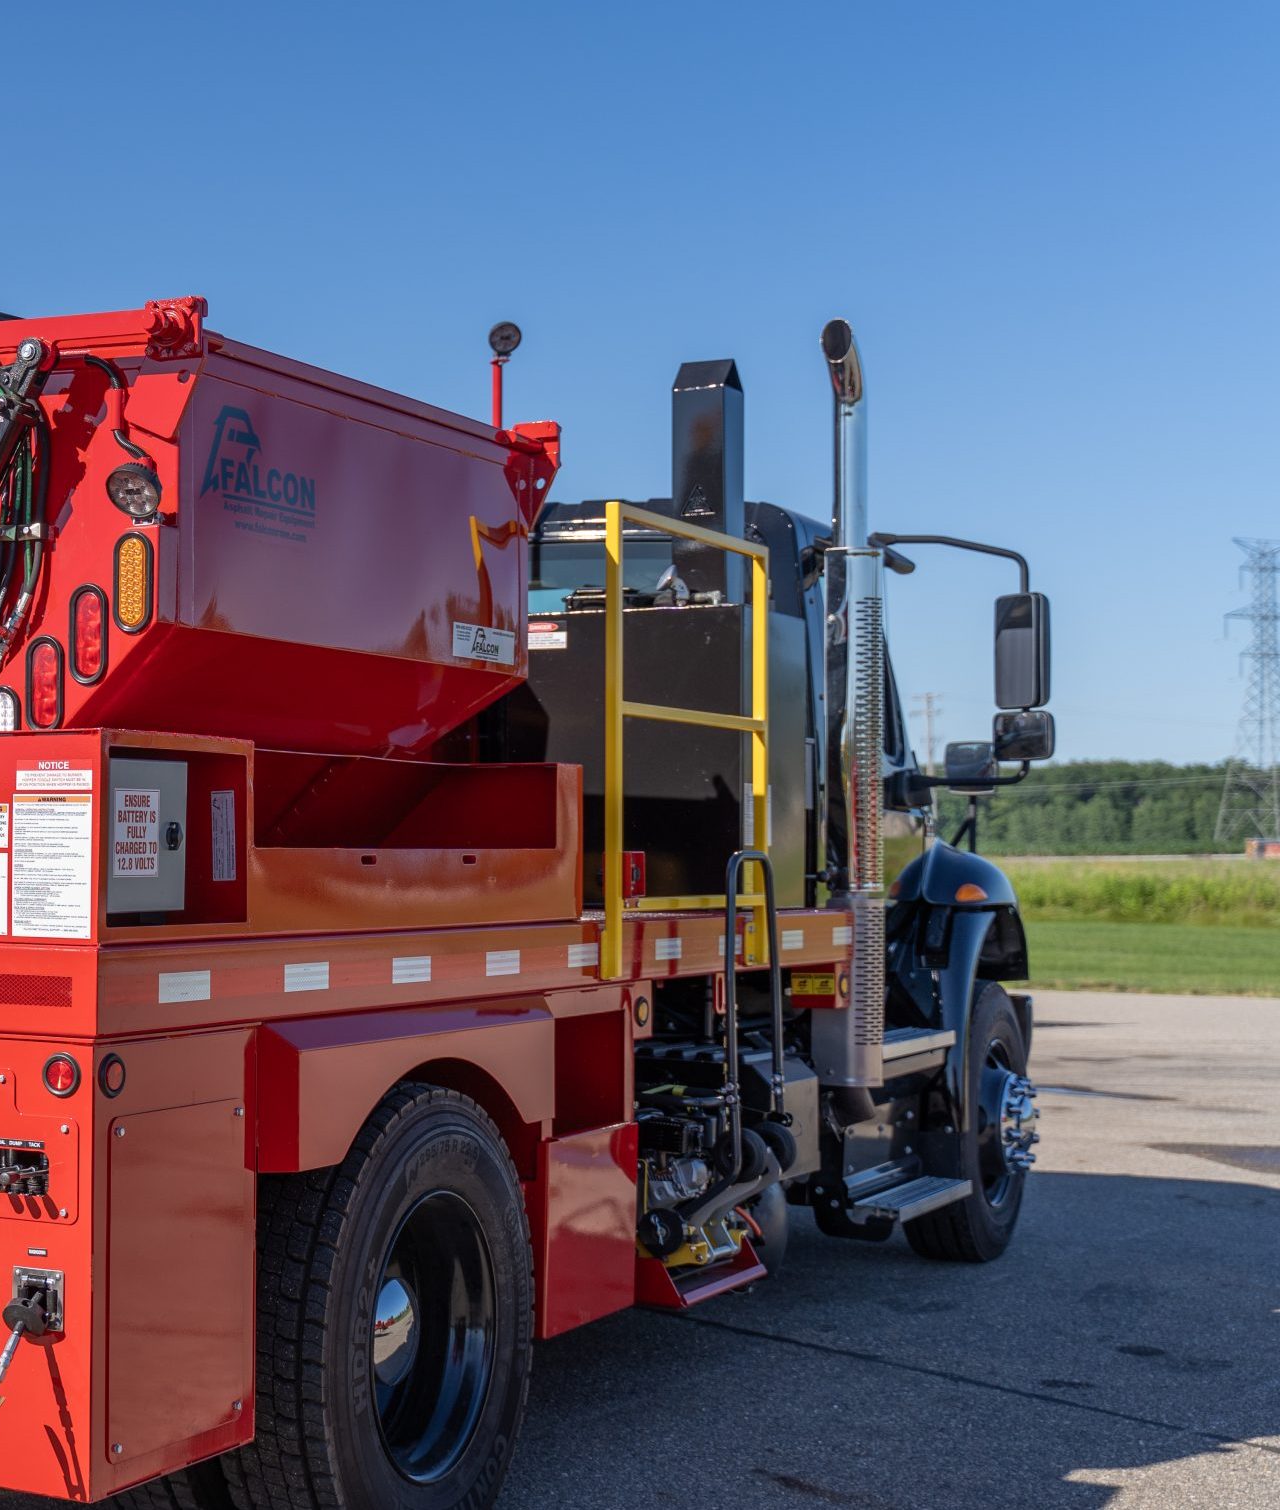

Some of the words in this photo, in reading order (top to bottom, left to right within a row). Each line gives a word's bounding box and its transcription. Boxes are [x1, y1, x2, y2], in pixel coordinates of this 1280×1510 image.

[221, 457, 316, 510] FALCON
[475, 642, 499, 655] FALCON
[38, 761, 70, 770] NOTICE
[124, 794, 150, 808] ENSURE
[118, 810, 148, 823] BATTERY
[149, 811, 156, 824] IS
[127, 825, 147, 839] FULLY
[115, 841, 147, 854] CHARGED
[148, 841, 157, 854] TO
[117, 858, 133, 870] 12.8
[134, 857, 155, 870] VOLTS
